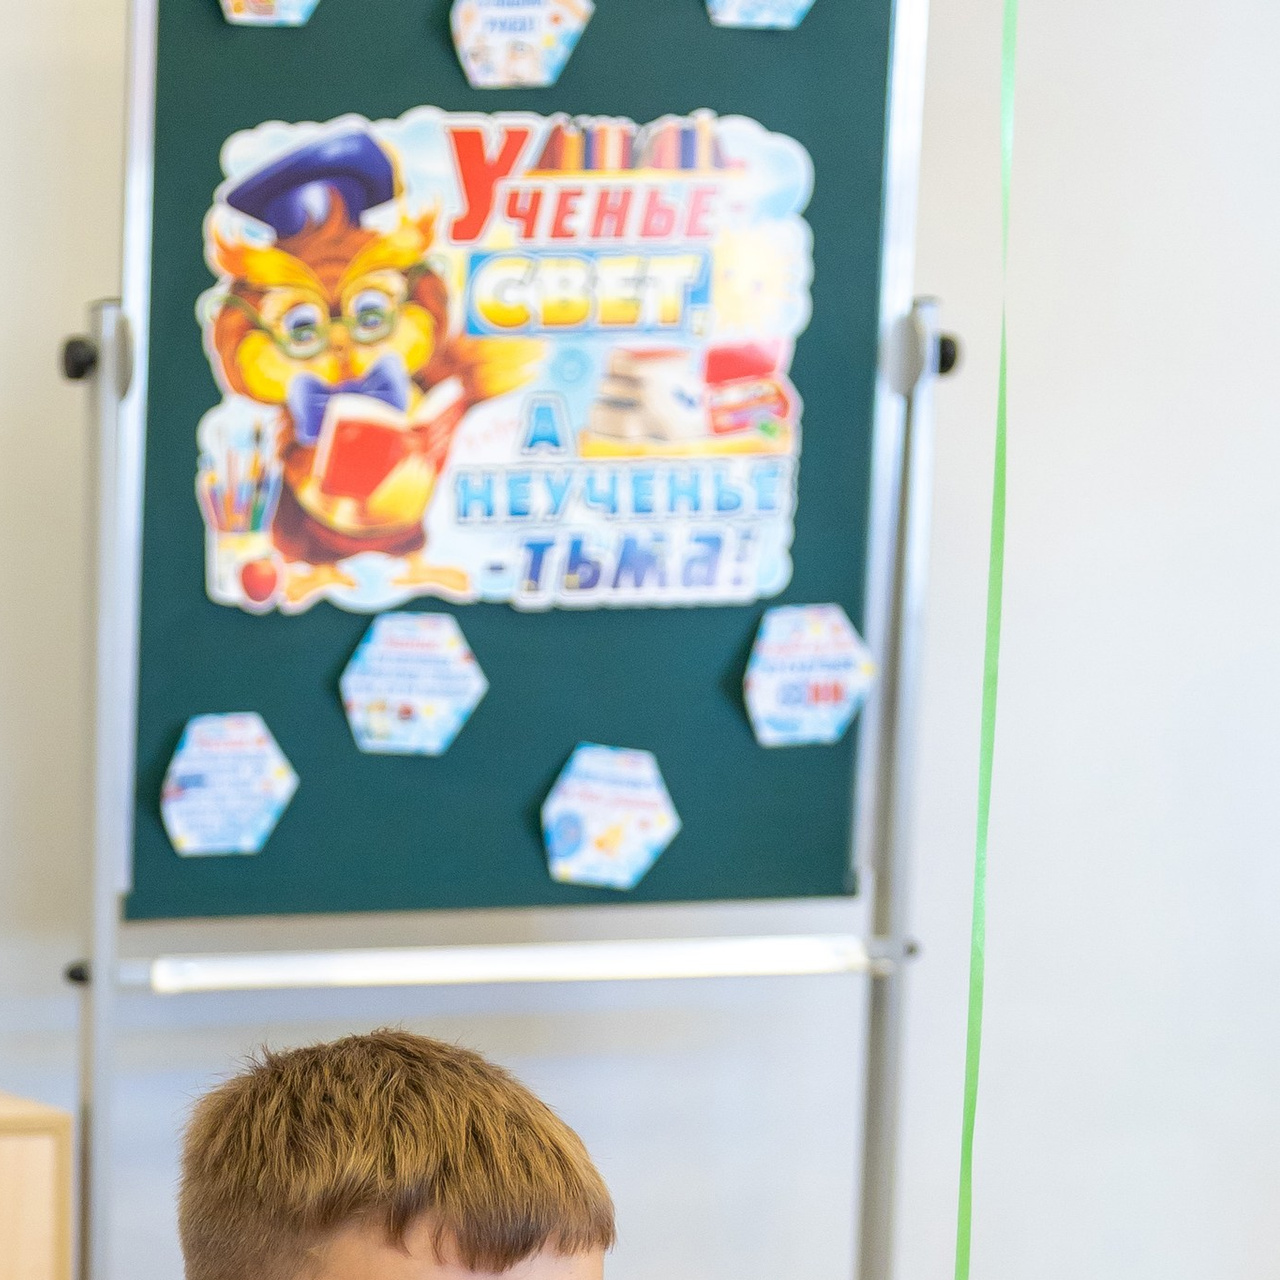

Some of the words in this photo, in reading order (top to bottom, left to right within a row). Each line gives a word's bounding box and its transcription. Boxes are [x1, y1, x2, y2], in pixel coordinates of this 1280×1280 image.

[448, 127, 718, 240] УЧЕНЬЕ
[526, 403, 561, 449] А
[457, 465, 780, 518] НЕУЧЕНЬЕ
